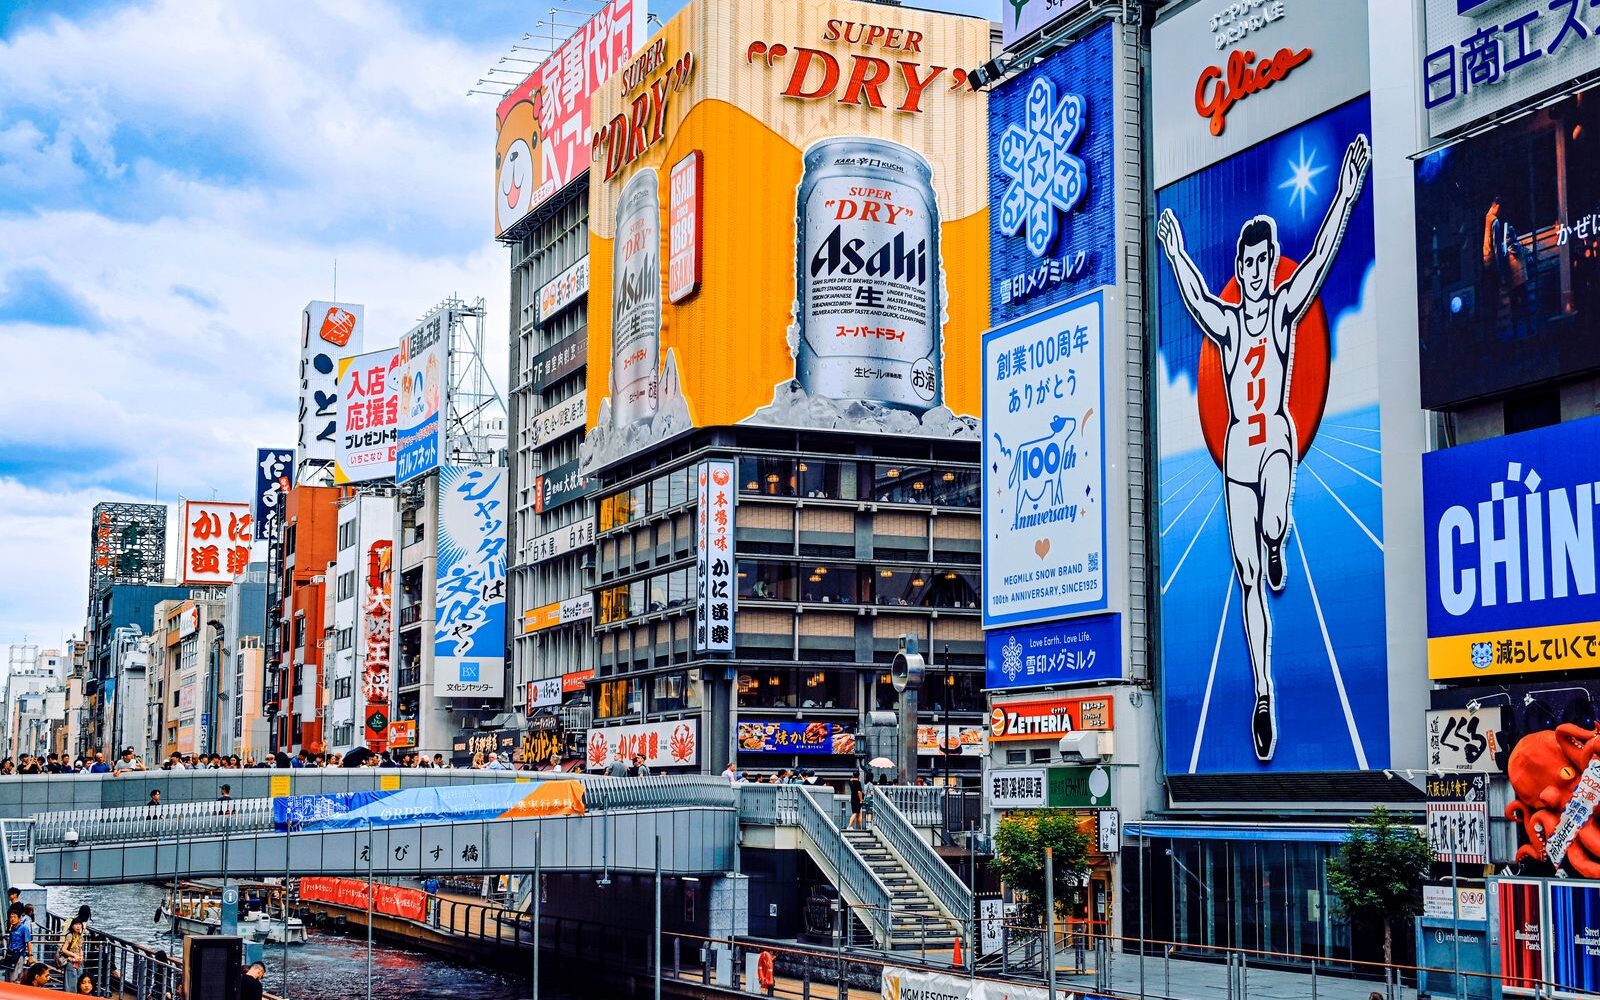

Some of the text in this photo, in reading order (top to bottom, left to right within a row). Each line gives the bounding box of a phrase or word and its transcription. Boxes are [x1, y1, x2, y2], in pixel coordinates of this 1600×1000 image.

[823, 19, 923, 53] SUPER
[621, 37, 665, 98] SUPER
[1195, 47, 1313, 137] Glico
[671, 164, 695, 209] ASAHI
[849, 186, 892, 200] SUPER
[670, 212, 694, 255] 1889
[811, 223, 926, 286] Asahi
[616, 252, 656, 322] Asahi
[670, 253, 694, 295] OSAKA
[1000, 250, 1086, 305] 雪印メグミルク
[855, 285, 885, 309] 生
[836, 325, 905, 342] スーパードライ
[996, 324, 1089, 381] 創業100周年
[346, 366, 386, 401] 入店
[533, 364, 545, 389] 7F
[1008, 368, 1077, 414] ありがとう
[1244, 336, 1267, 447] グリコ
[397, 438, 437, 479] ガルフネット
[192, 510, 254, 541] かに
[713, 490, 729, 552] 本場の味
[1010, 503, 1078, 531] Anniversary
[533, 537, 555, 562] 白木屋
[569, 522, 593, 548] 白木屋
[1004, 563, 1083, 586] MEGMILK SNOW BRAND
[992, 595, 1009, 606] 100th
[1030, 632, 1092, 649] Love Earth. Love Life.
[1496, 634, 1600, 666] 減らしていくで
[462, 665, 476, 677] BX
[1026, 649, 1097, 676] 雪印メグミルク
[1007, 712, 1072, 734] ZETTERIA
[359, 844, 479, 862] えびす橋
[900, 987, 919, 1000] MGM
